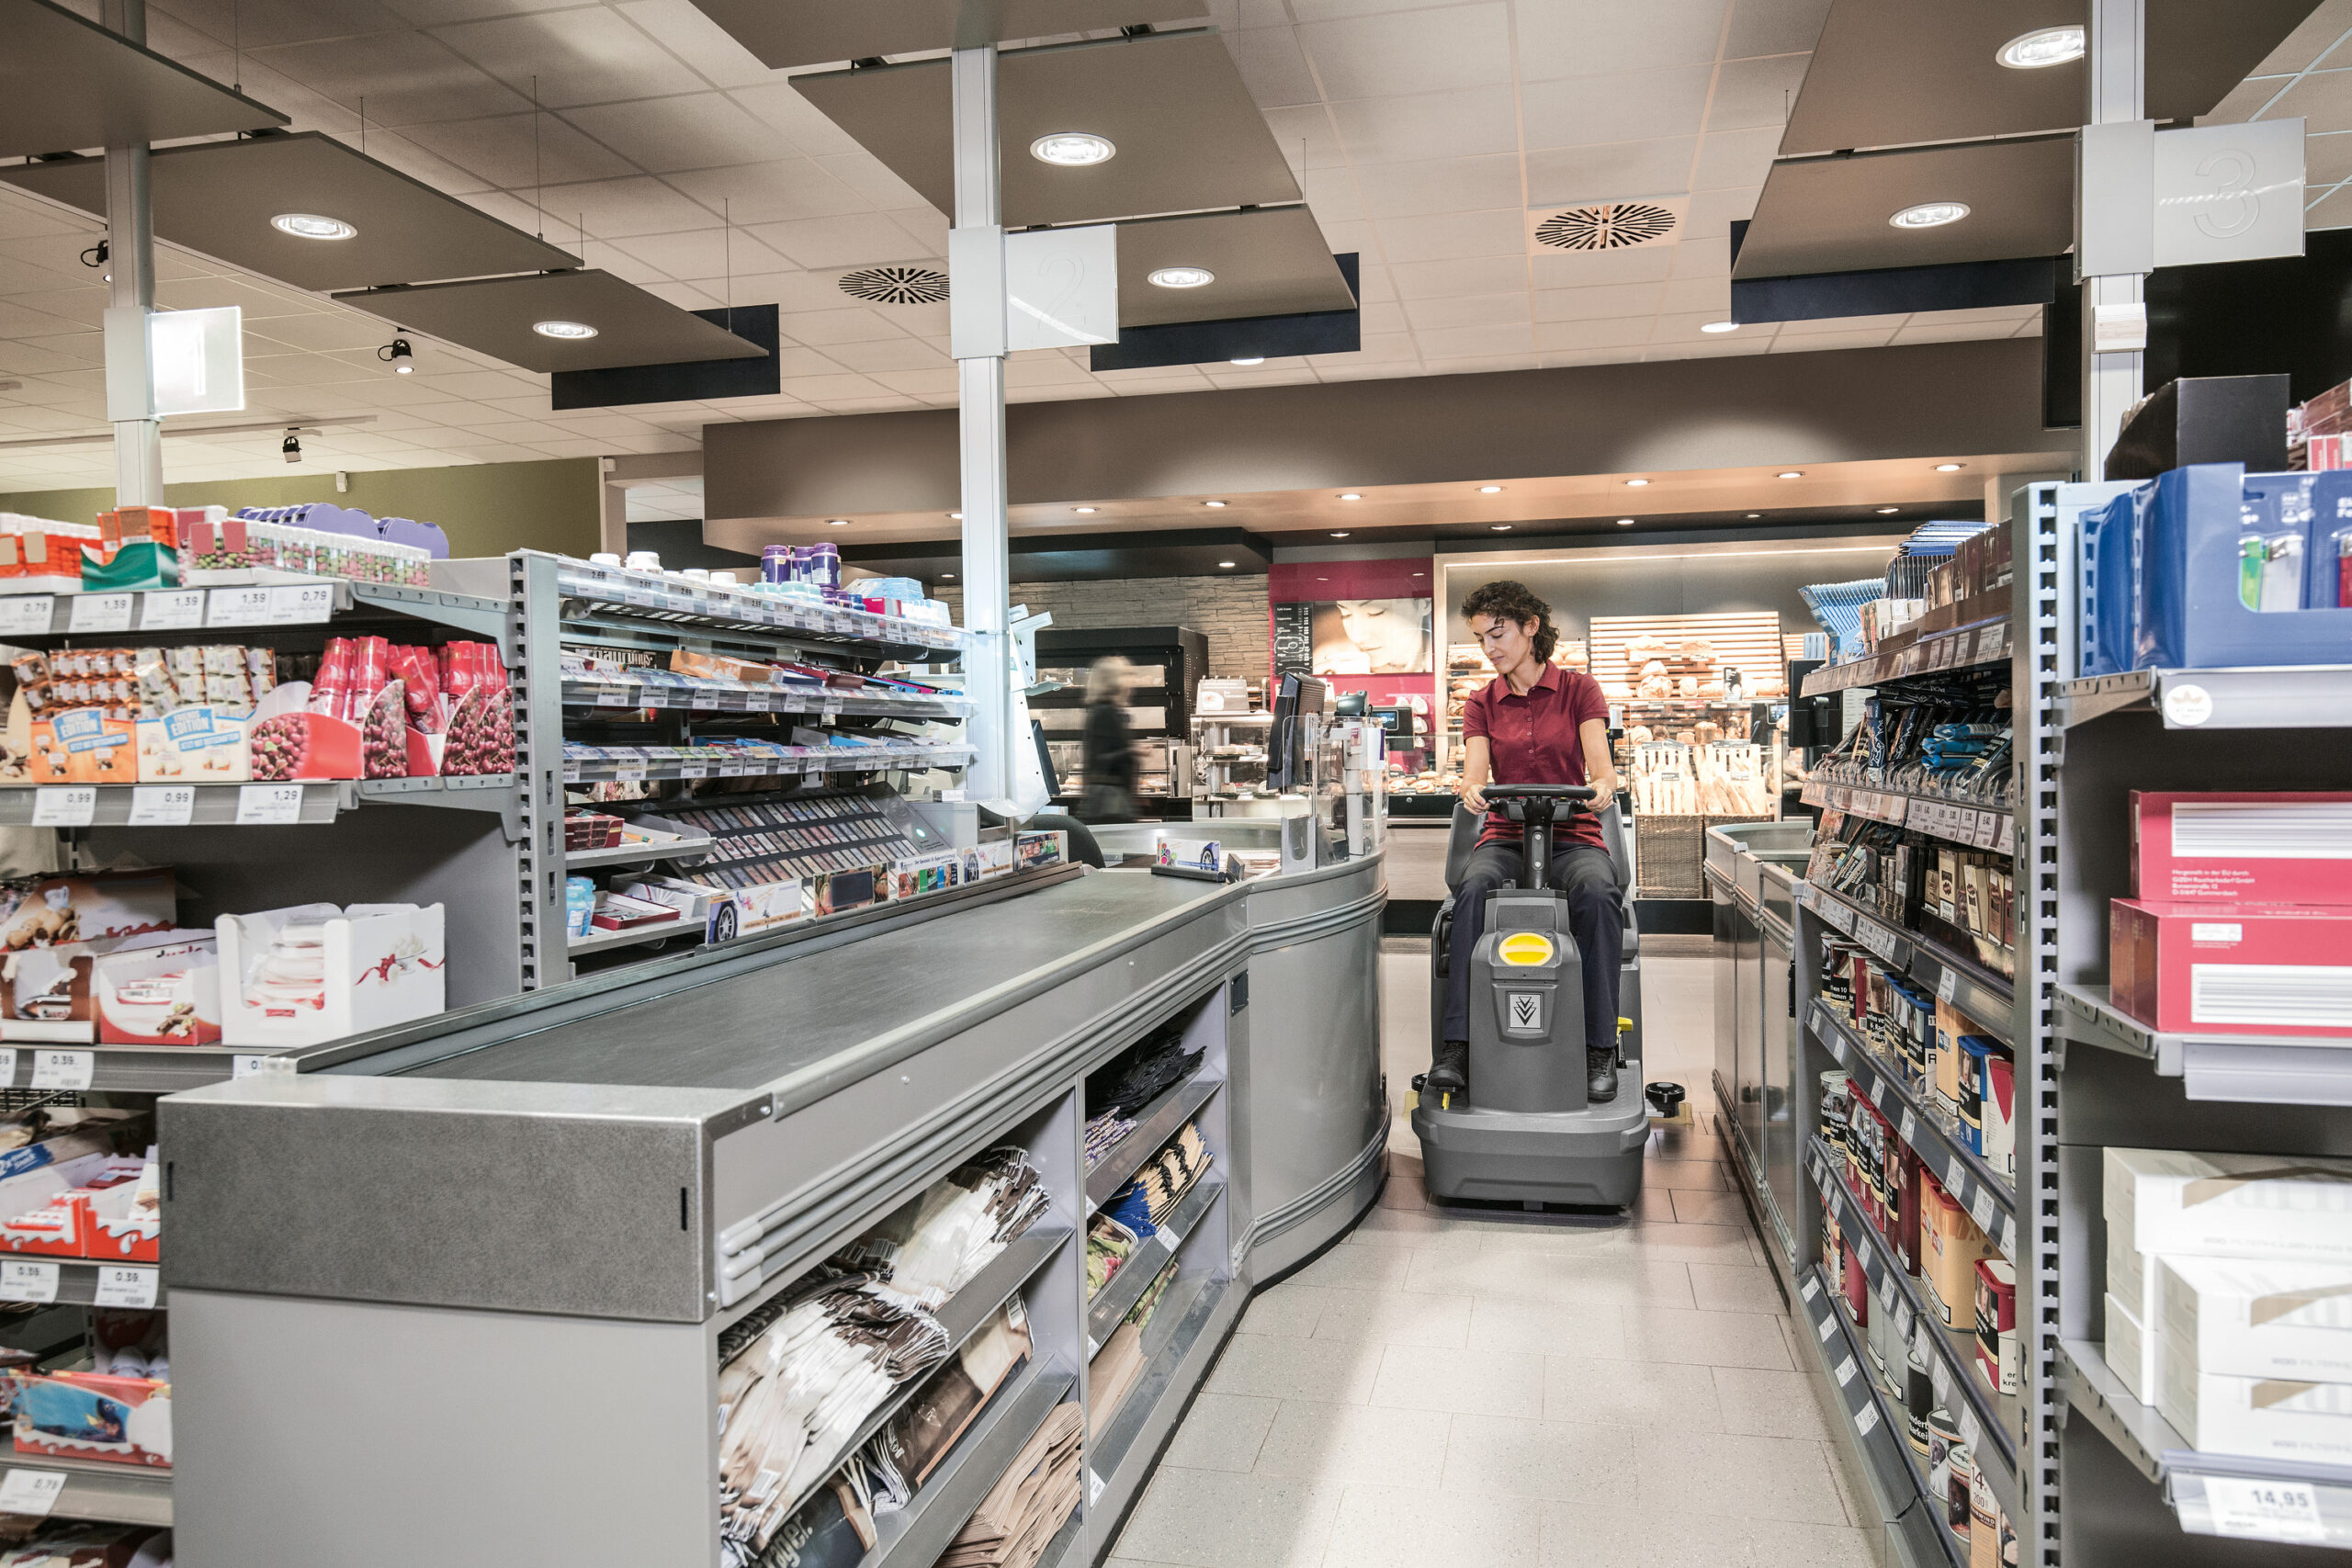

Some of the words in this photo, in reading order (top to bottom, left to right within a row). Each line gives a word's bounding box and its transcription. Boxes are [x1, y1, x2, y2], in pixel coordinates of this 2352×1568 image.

[2193, 148, 2260, 239] 3
[1037, 249, 1086, 332] 2
[242, 593, 266, 604] 1,39
[274, 790, 298, 802] 1,29
[2253, 1489, 2310, 1509] 14,95
